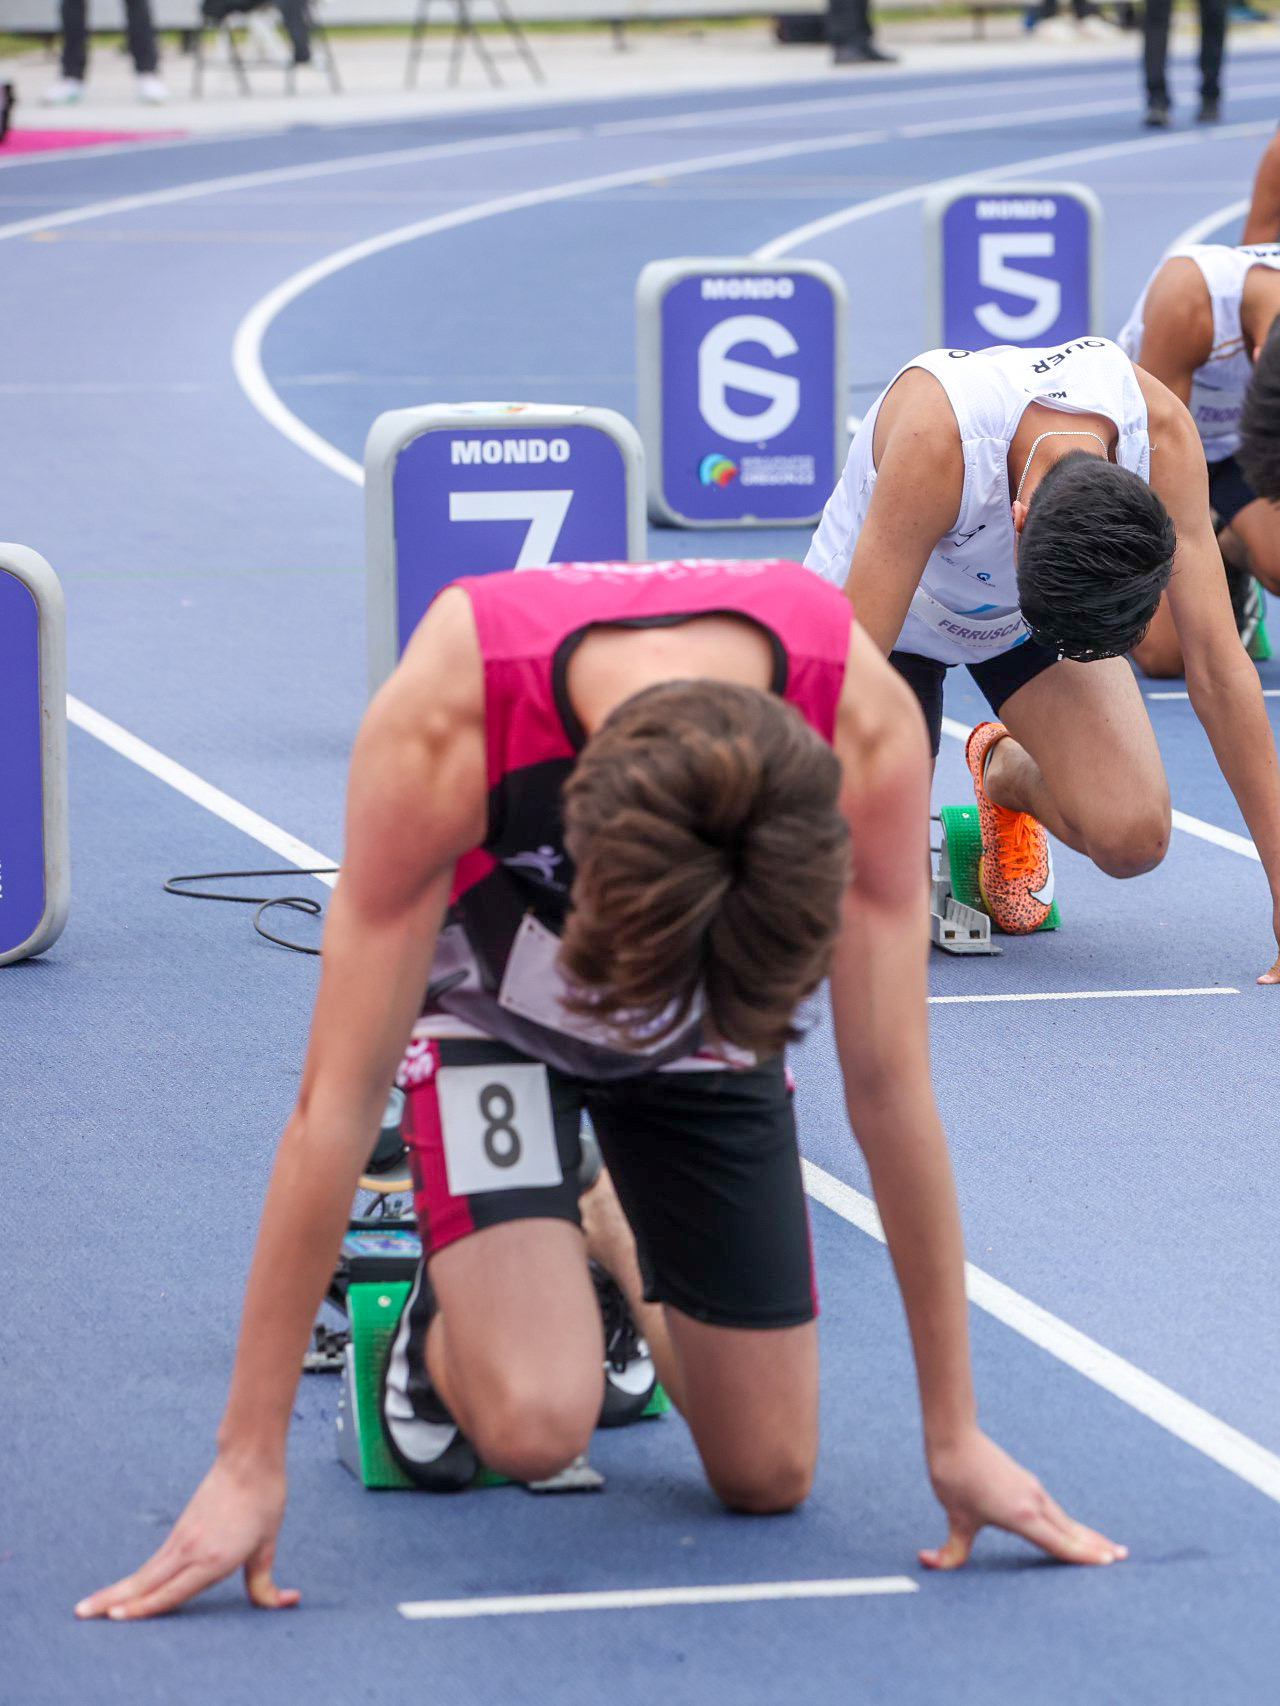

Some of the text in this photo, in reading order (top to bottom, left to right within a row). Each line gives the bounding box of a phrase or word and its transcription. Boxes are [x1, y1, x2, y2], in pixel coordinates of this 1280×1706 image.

[975, 199, 1057, 220] MONDO
[700, 278, 795, 300] MONDO
[974, 231, 1062, 342] 5
[697, 314, 801, 443] 6
[450, 437, 571, 466] MONDO
[449, 489, 575, 574] 7
[937, 619, 1022, 641] FERRUSCA
[478, 1081, 522, 1169] 8
